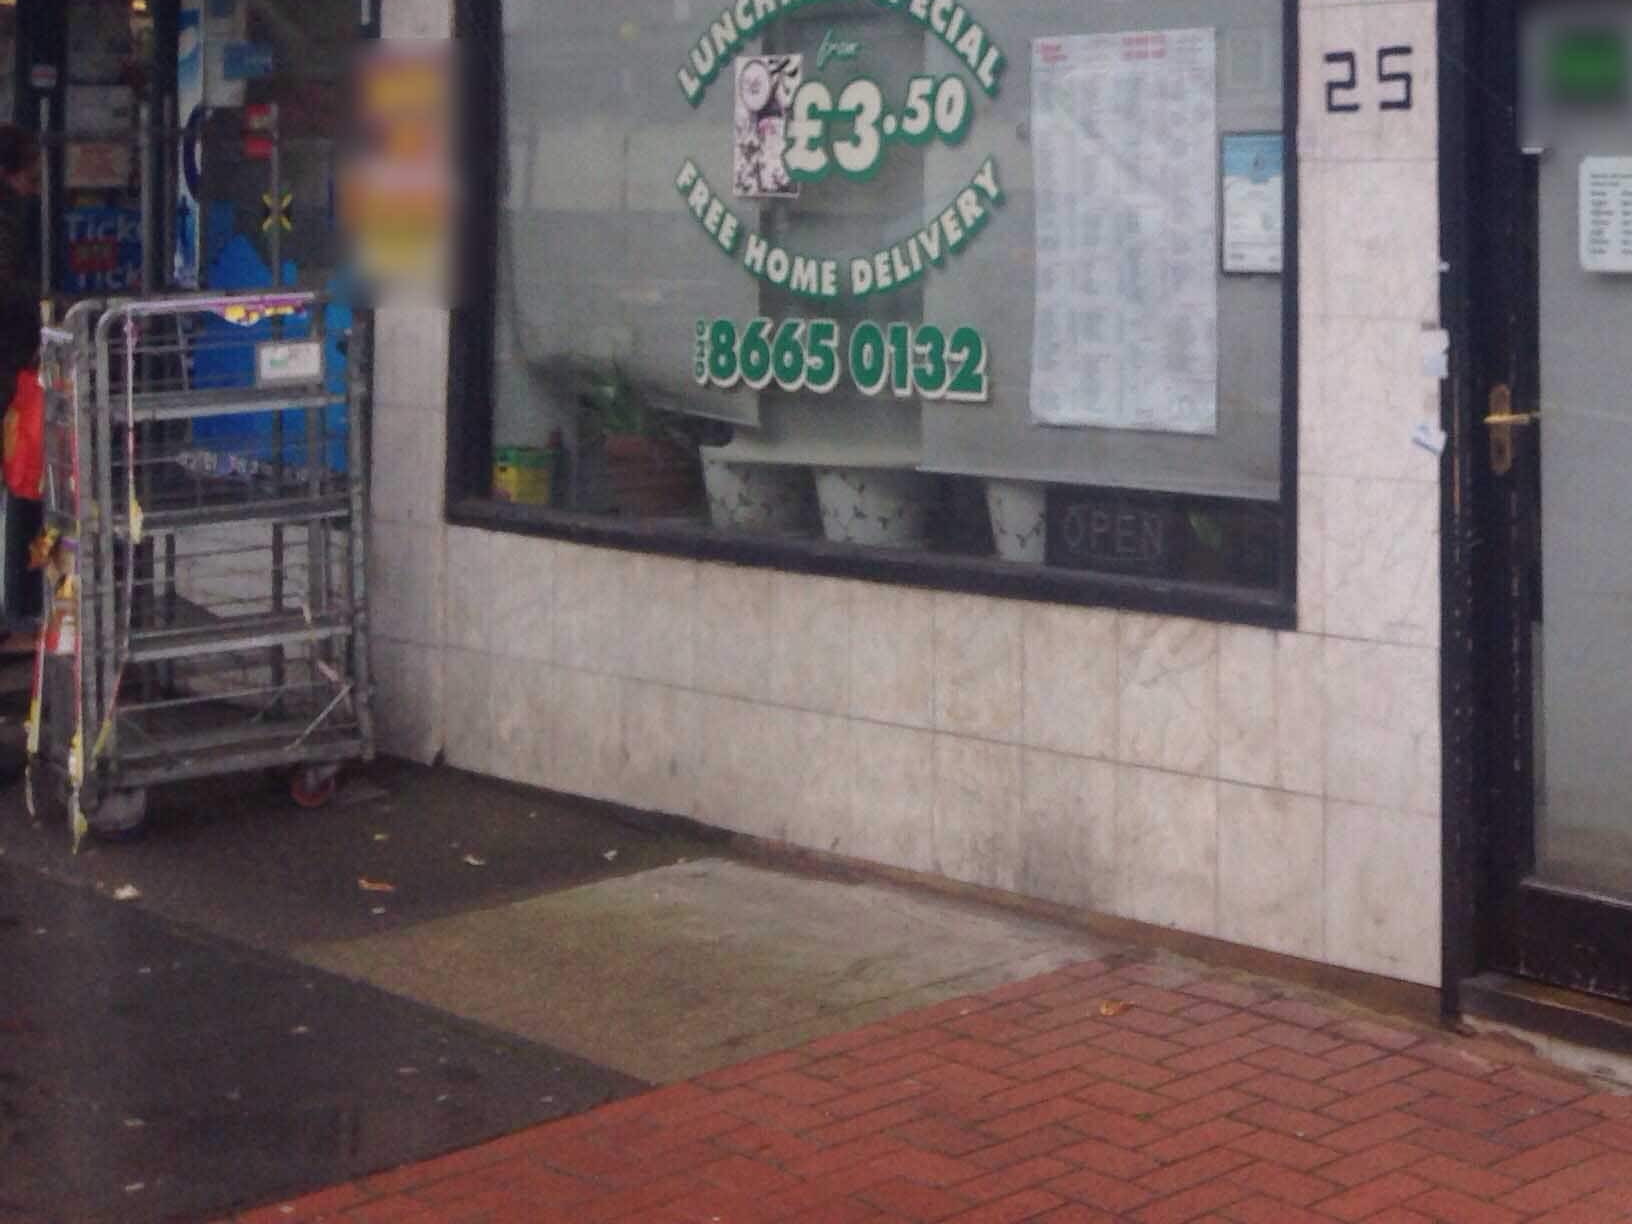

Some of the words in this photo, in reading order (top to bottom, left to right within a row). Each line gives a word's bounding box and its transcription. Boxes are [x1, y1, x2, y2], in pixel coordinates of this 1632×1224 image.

[1323, 45, 1413, 113] 25
[784, 76, 971, 180] £3.50
[675, 158, 739, 253] FREE
[743, 232, 839, 300] HOME
[850, 157, 1004, 299] DELIVERY
[707, 317, 840, 394] 8665
[848, 321, 988, 402] 0132
[1062, 504, 1165, 559] OPEN
